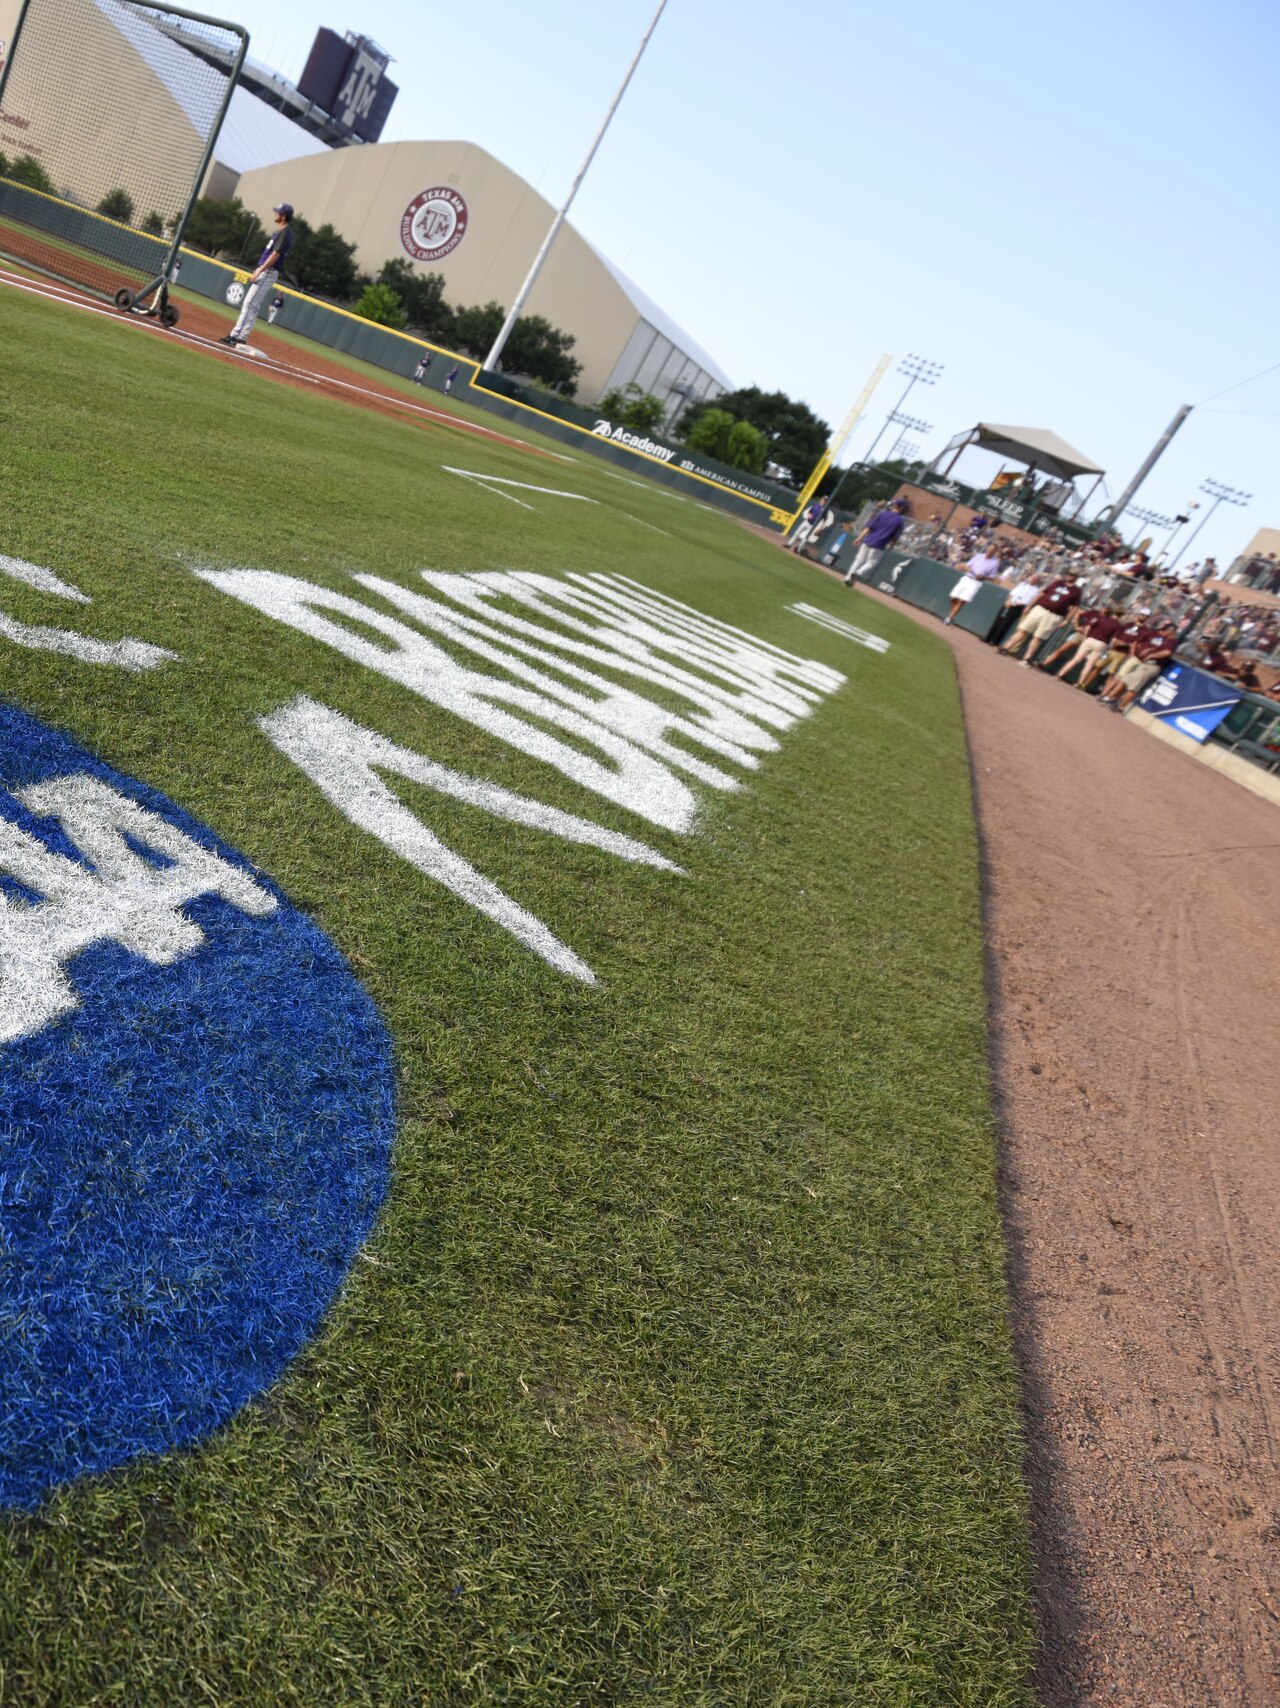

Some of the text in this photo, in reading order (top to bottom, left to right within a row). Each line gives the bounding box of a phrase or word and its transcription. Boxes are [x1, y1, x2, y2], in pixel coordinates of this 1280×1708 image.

[421, 189, 452, 201] TEXAS
[402, 215, 463, 259] BUILDING CHAMPIONS
[611, 426, 676, 463] Academy
[694, 465, 772, 503] AMERICAN CAMPUS
[195, 568, 849, 835] BASEBALL
